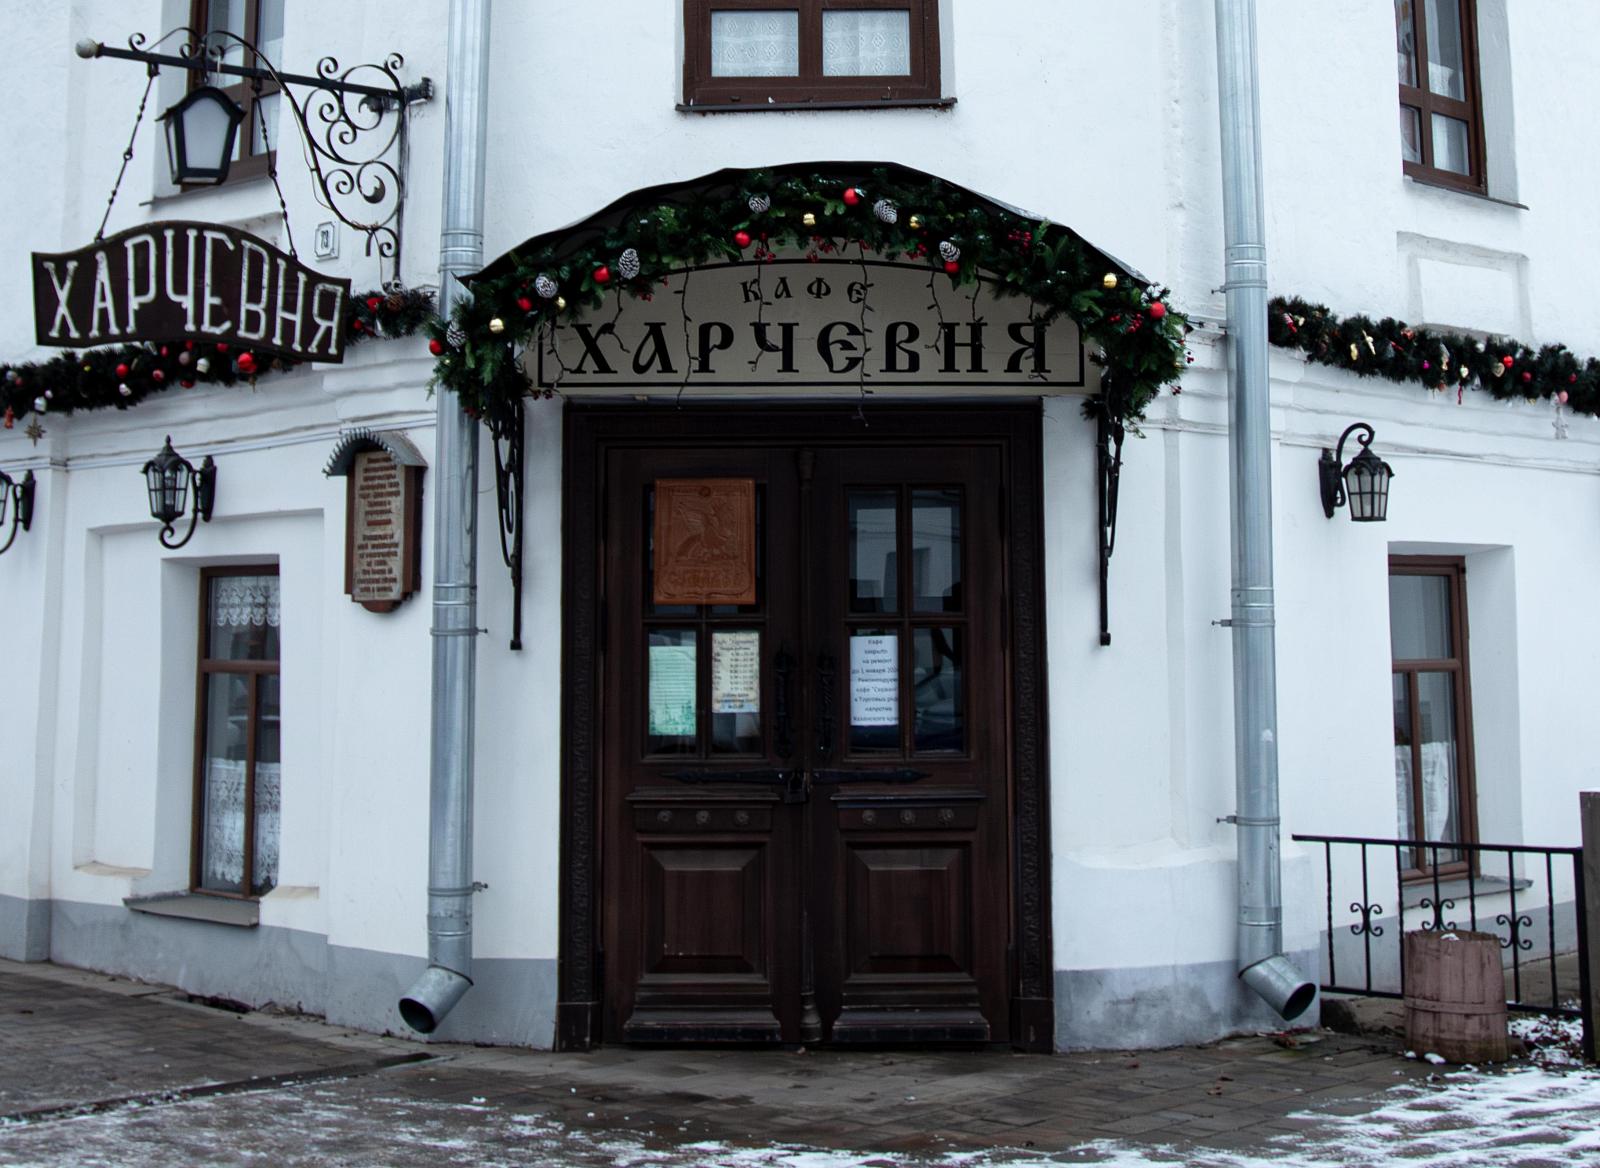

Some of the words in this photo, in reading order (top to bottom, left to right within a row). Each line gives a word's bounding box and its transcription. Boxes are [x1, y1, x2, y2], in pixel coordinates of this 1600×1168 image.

[43, 229, 343, 355] ХАРЧЕВНЯ
[741, 276, 866, 304] КАФЕ
[570, 321, 1052, 375] ХАРЧЕВНЯ
